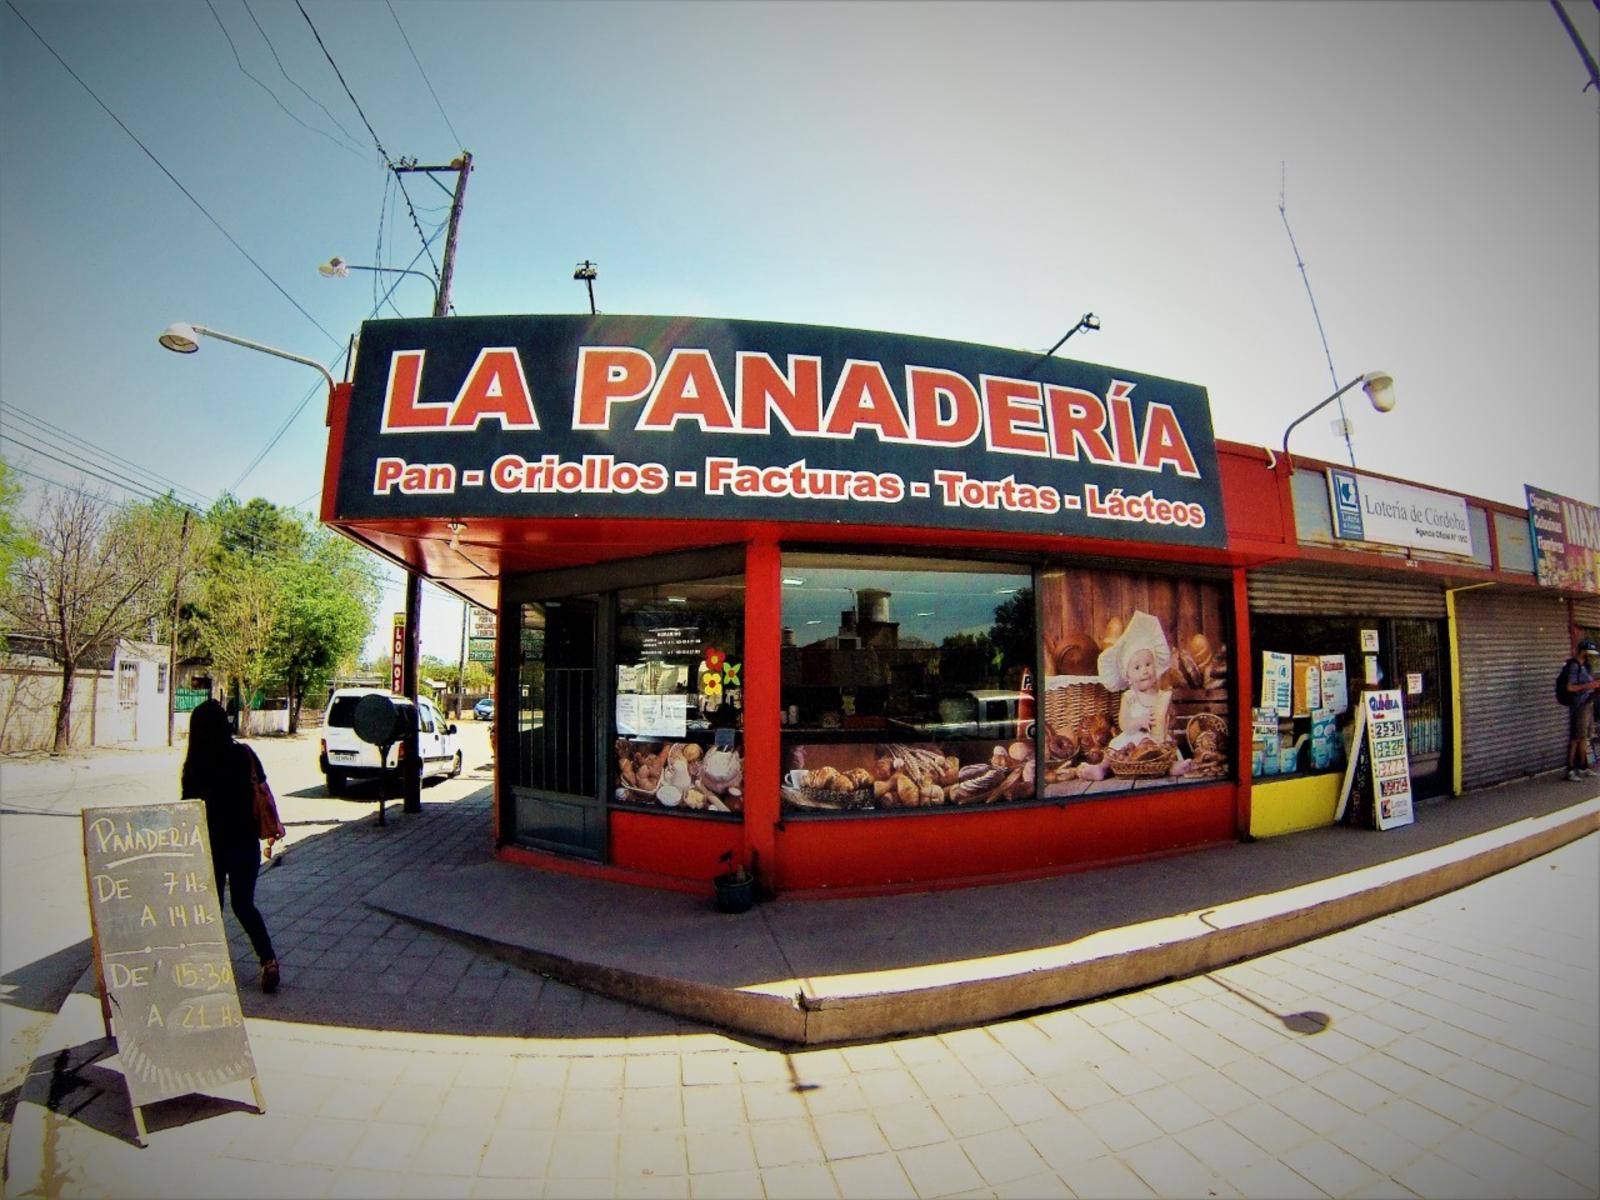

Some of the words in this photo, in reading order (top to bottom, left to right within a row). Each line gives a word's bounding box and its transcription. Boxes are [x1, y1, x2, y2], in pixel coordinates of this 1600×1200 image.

[380, 347, 540, 434] LA
[571, 346, 1201, 479] PANADERÍA
[373, 457, 456, 495] Pan
[490, 455, 669, 495] Criollos
[704, 456, 905, 502] Facturas
[934, 469, 1060, 515] Tortas
[1085, 483, 1206, 528] Lácteos
[1365, 494, 1408, 521] Lotería
[1410, 504, 1423, 524] de
[94, 874, 132, 903] DE
[163, 872, 178, 895] 7
[140, 904, 157, 927] A
[168, 904, 187, 927] 14
[111, 962, 149, 989] DE
[146, 1003, 164, 1028] A
[182, 1004, 211, 1029] 21
